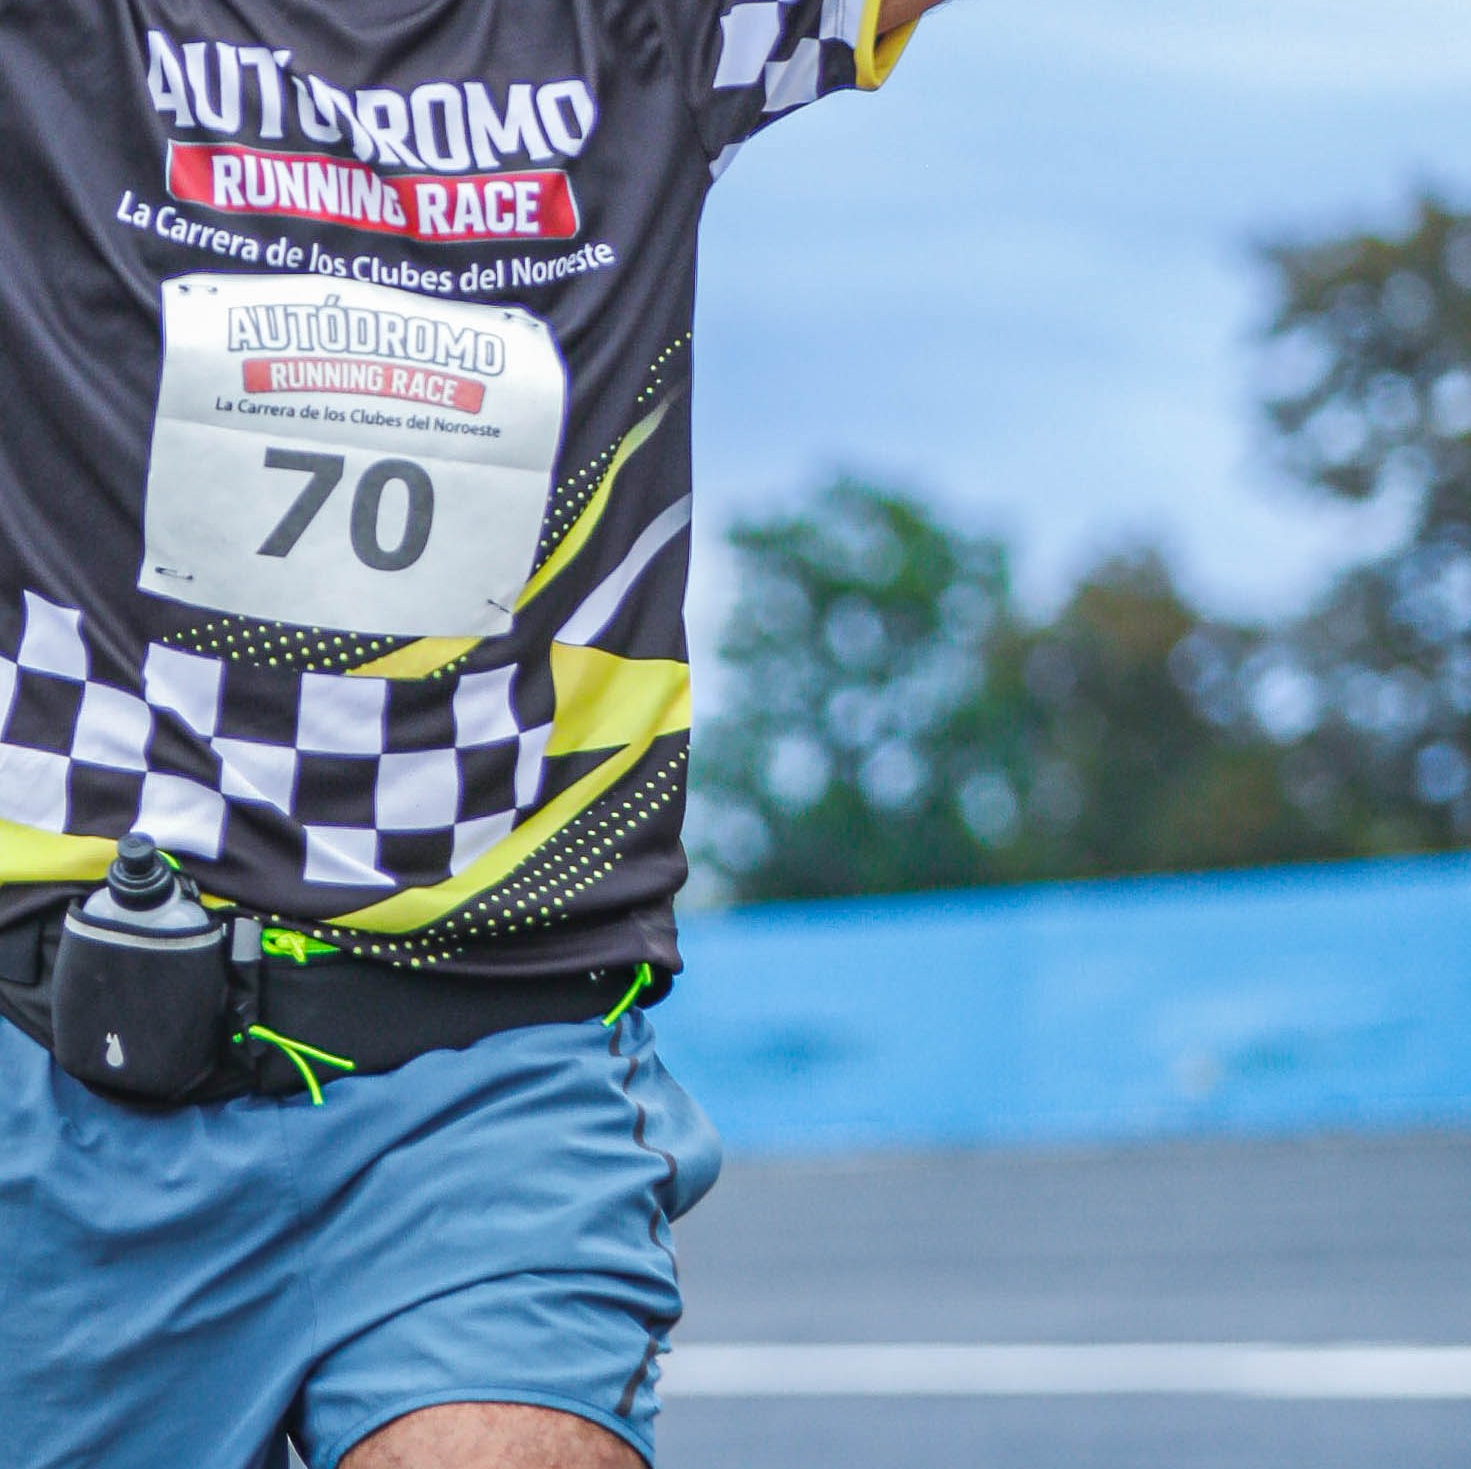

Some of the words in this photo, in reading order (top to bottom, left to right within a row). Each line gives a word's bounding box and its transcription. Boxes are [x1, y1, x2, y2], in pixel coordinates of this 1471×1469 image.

[212, 152, 407, 228] RUNNING
[416, 180, 540, 235] RACE
[116, 190, 151, 229] La
[156, 205, 259, 263] Carrera
[265, 236, 304, 269] de
[309, 242, 345, 277] los
[351, 255, 453, 294] Clubes
[459, 258, 504, 293] del
[511, 241, 615, 288] Noroeste
[228, 294, 505, 376] AUTÓDROMO
[215, 396, 233, 412] La
[238, 398, 296, 418] Carrera
[300, 403, 320, 421] de
[324, 406, 346, 423] los
[350, 408, 402, 428] Clubes
[406, 413, 431, 431] del
[434, 416, 502, 438] Noroeste
[270, 362, 384, 392] RUNNING
[391, 367, 459, 406] RACE
[256, 446, 435, 572] 70
